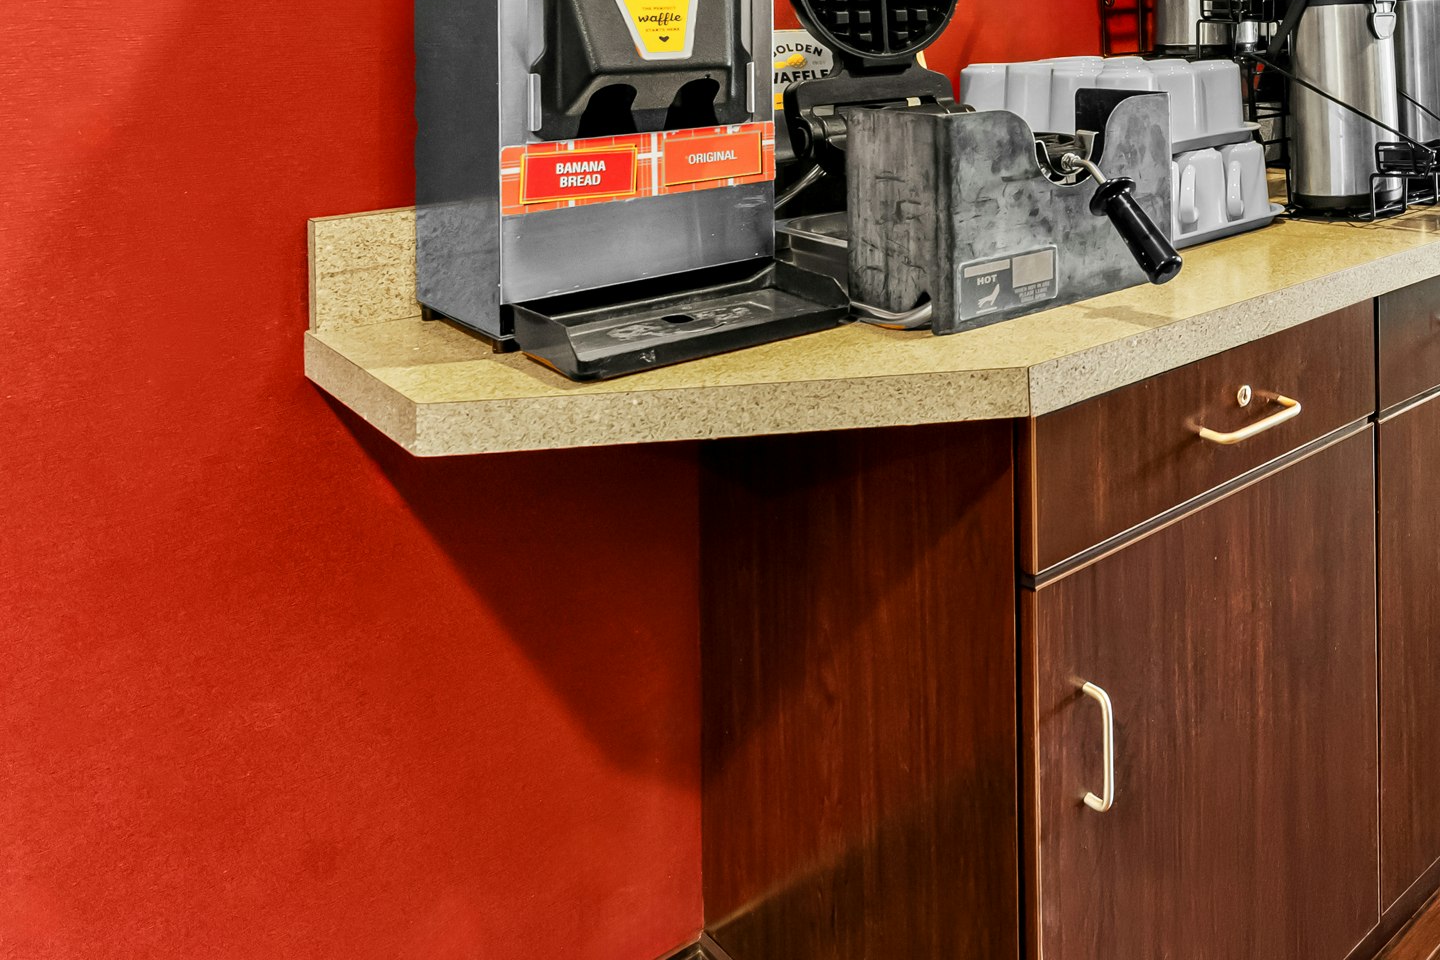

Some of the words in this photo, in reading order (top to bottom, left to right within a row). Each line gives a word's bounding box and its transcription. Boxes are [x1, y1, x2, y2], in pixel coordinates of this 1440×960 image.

[638, 12, 682, 26] waffle
[774, 43, 823, 57] OLDEN
[688, 149, 737, 165] ORIGINAL
[555, 160, 606, 175] BANANA
[559, 173, 601, 188] BREAD
[977, 274, 998, 285] HOT
